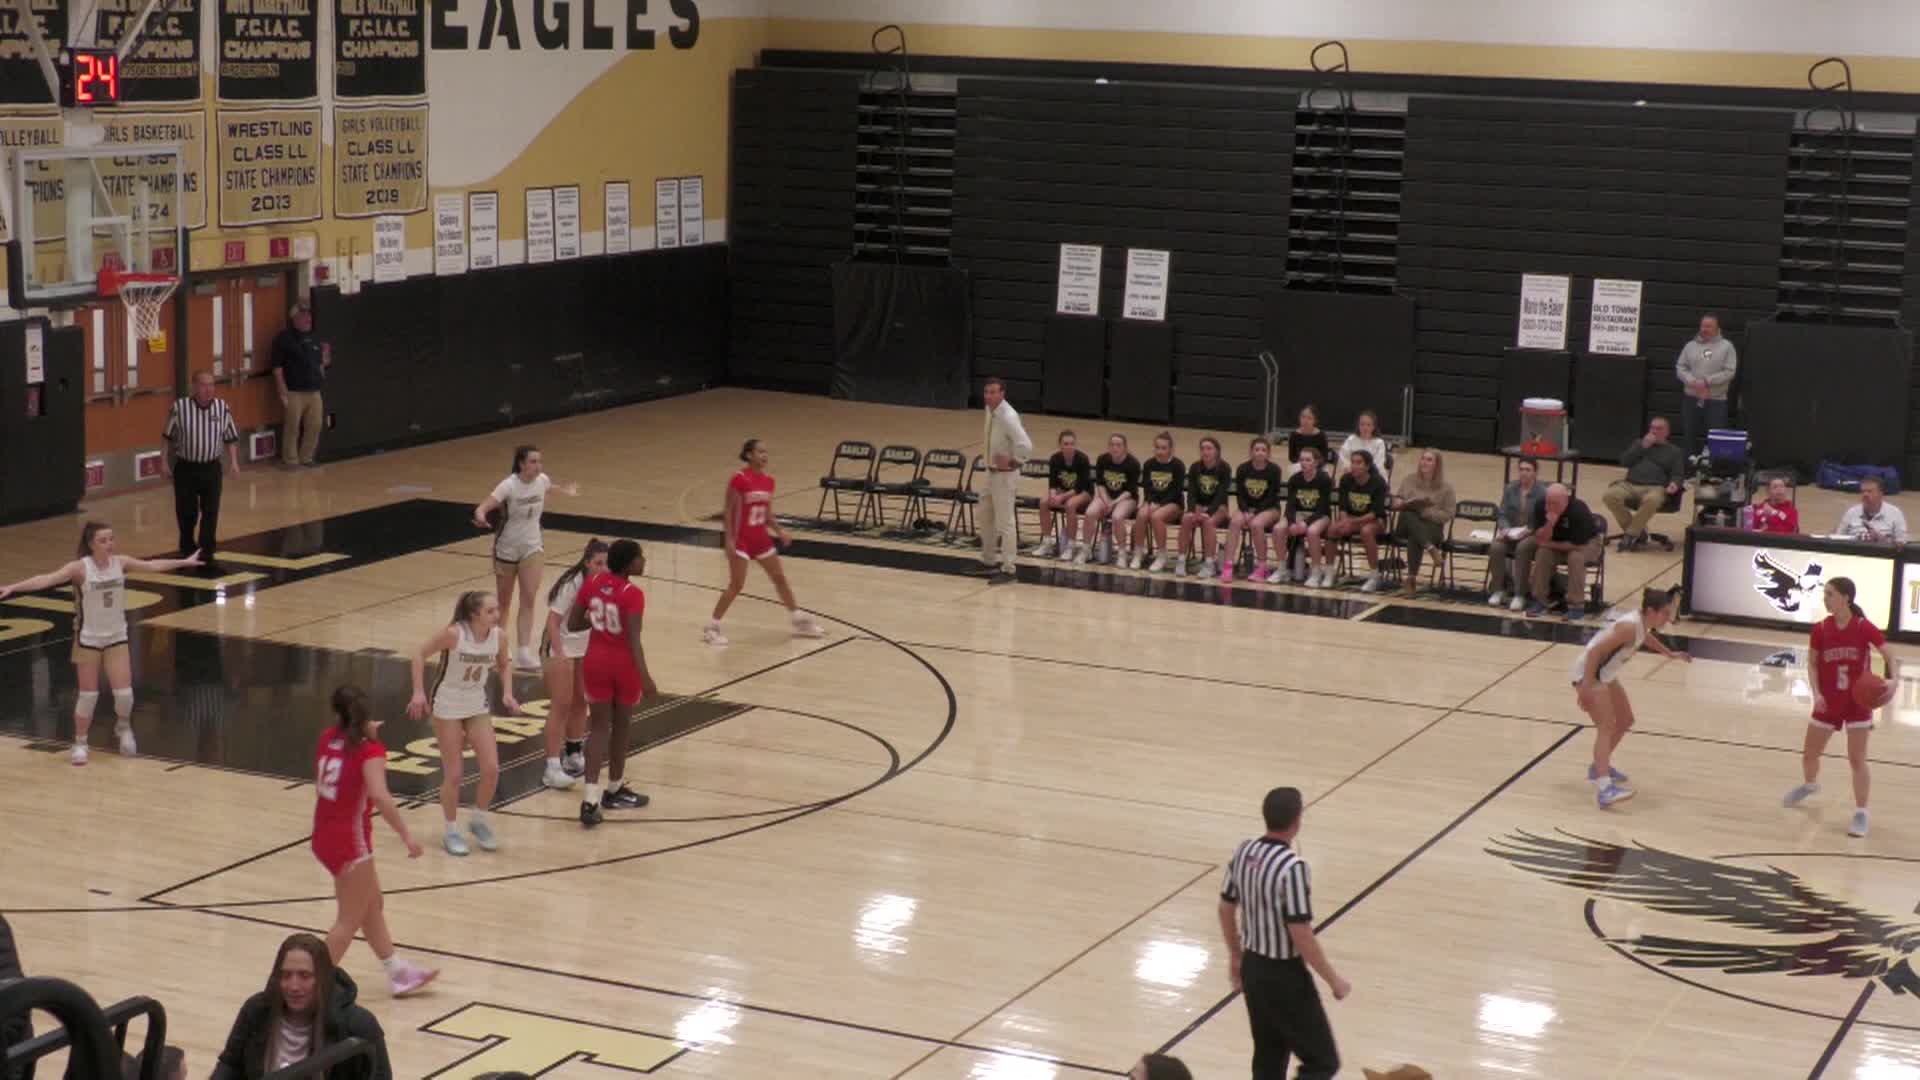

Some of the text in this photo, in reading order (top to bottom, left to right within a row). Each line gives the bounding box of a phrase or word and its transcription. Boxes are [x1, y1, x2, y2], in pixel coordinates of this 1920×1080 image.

[431, 0, 699, 50] EAGLES
[76, 54, 115, 101] 24
[133, 124, 195, 141] BASKETBALL
[228, 121, 313, 138] WRESTLING
[370, 117, 421, 132] VOLLEYBALL
[233, 144, 308, 162] CLASS LL
[347, 140, 415, 156] CLASS LL
[226, 166, 315, 190] STATE CHAMPIONS
[342, 161, 422, 184] STATE CHAMPIONS
[251, 195, 291, 211] 2013
[103, 590, 113, 608] 5
[590, 597, 623, 634] 20
[463, 666, 484, 682] 14
[1837, 664, 1849, 690] 5
[318, 755, 343, 800] 12
